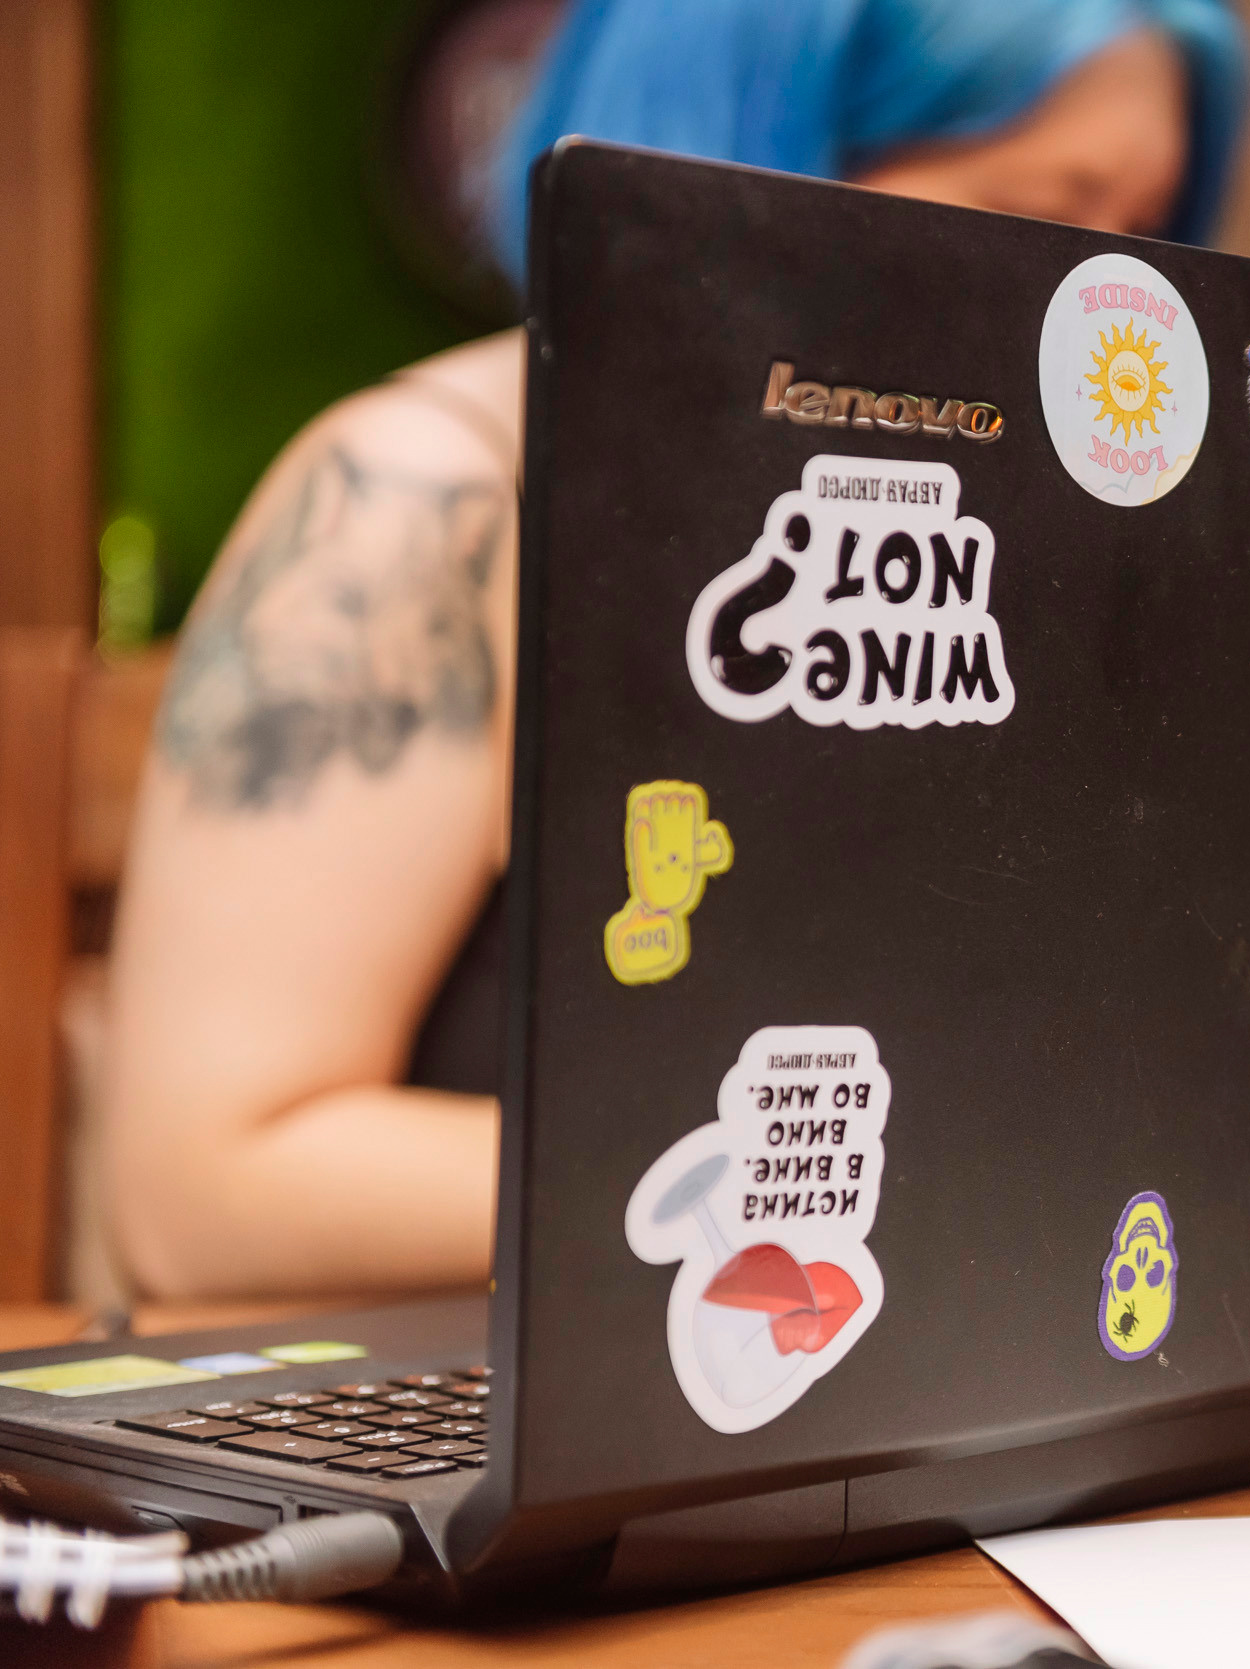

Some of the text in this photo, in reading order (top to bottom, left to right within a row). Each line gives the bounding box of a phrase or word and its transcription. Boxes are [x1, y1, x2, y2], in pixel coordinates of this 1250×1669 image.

[1079, 283, 1179, 331] INSIDE
[763, 362, 1003, 443] lenovo
[1087, 434, 1169, 476] LOOK
[624, 927, 668, 954] boo
